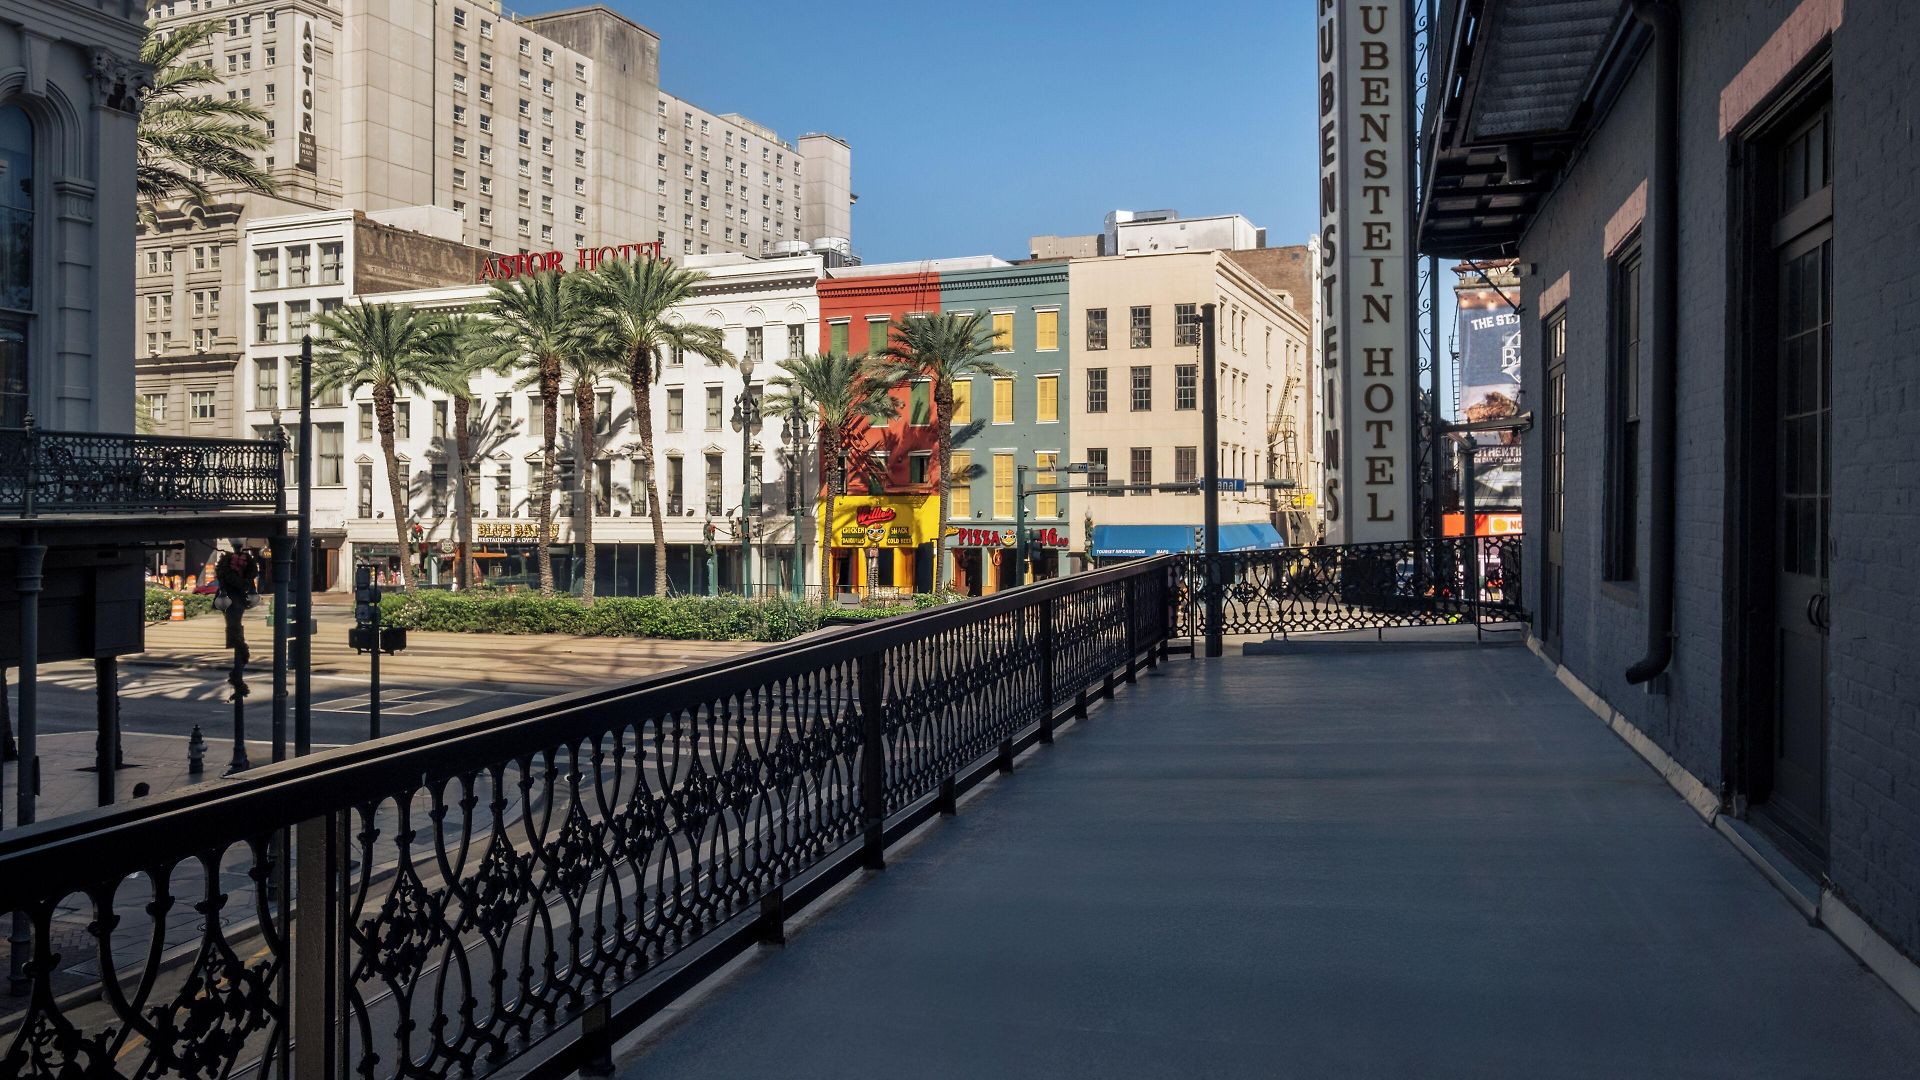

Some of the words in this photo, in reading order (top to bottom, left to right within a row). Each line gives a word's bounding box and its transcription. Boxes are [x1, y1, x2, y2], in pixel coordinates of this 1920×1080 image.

[302, 21, 312, 133] ASTOR
[479, 250, 566, 280] ASTOR
[1471, 316, 1495, 330] THE
[1364, 348, 1394, 522] HOTEL
[1217, 480, 1237, 490] anal
[478, 524, 511, 537] BLUE
[958, 527, 1001, 546] PIZZA
